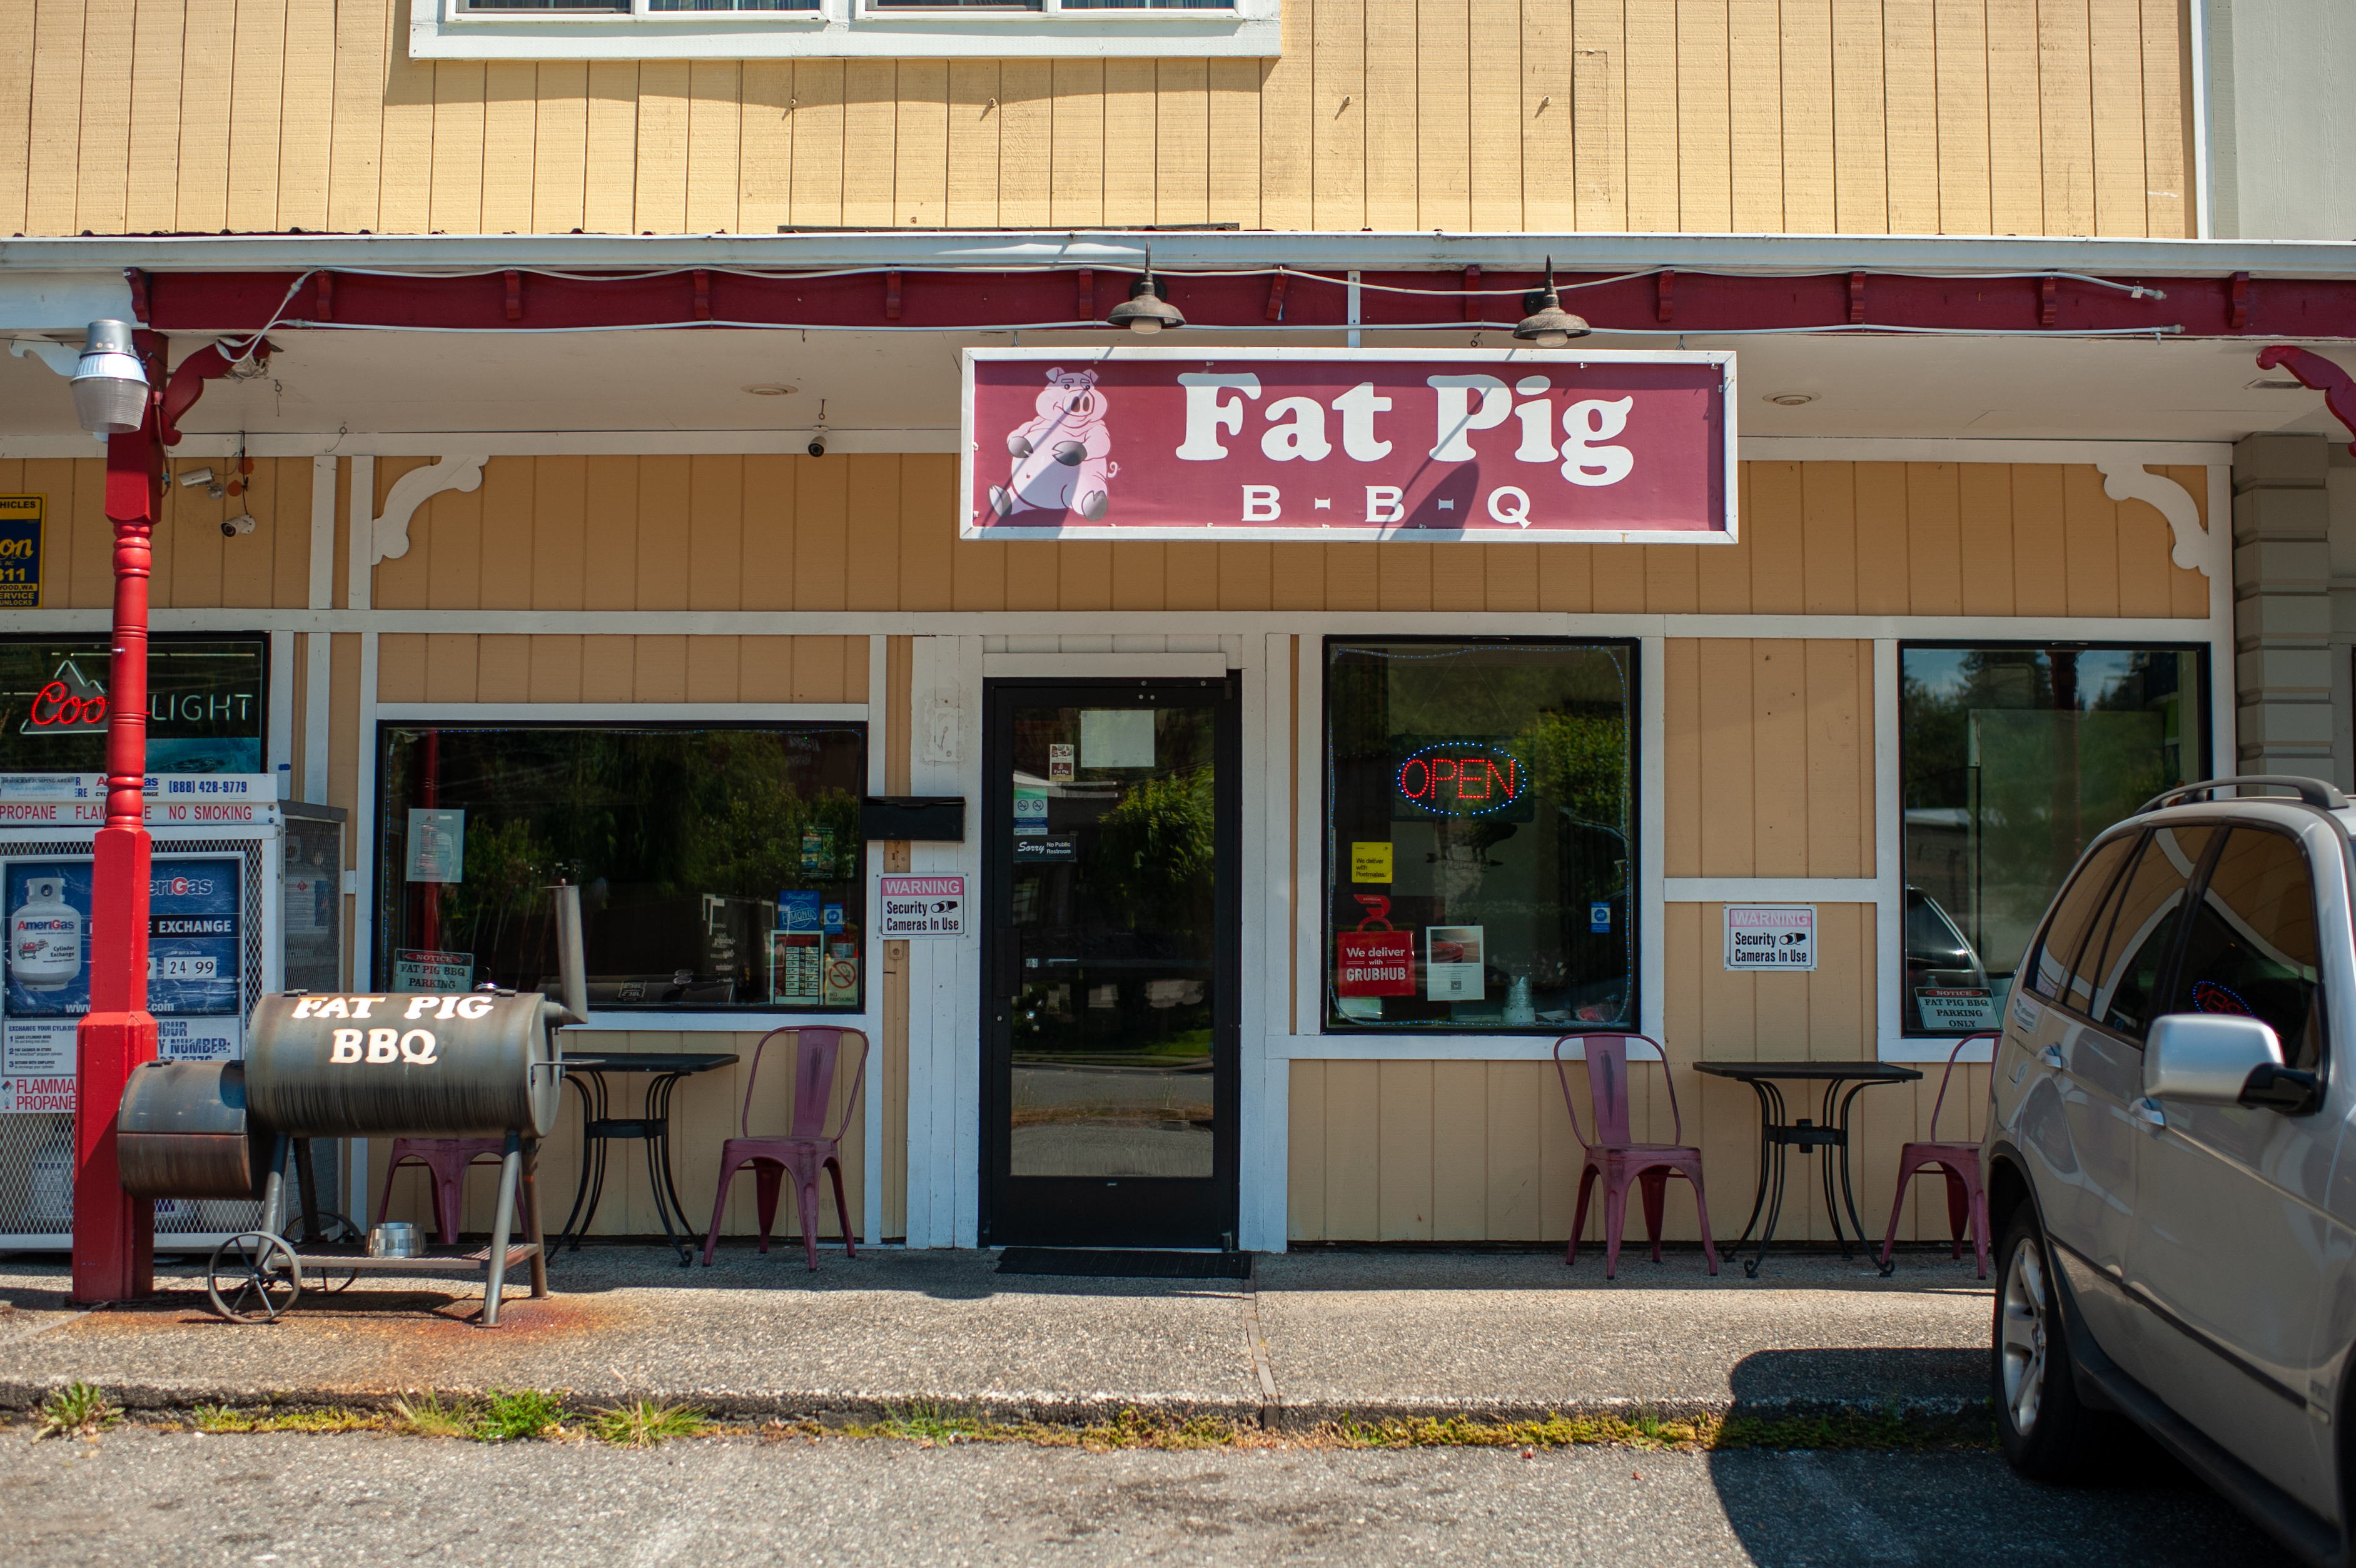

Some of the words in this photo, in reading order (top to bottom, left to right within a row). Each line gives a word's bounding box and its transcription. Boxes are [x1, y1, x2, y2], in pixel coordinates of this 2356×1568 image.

[1176, 372, 1393, 462] Fat
[1428, 374, 1635, 486] Pig
[0, 539, 34, 558] on
[31, 681, 110, 726] Coo
[151, 694, 253, 721] LIGHT
[1402, 758, 1515, 799] OPEN
[169, 781, 195, 794] (888)
[199, 781, 247, 793] 428-9779
[0, 806, 56, 820] PROPANE
[76, 806, 151, 820] FLAME
[169, 806, 186, 820] NO
[195, 806, 252, 821] SMOKING
[1018, 841, 1044, 854] Sorry
[149, 876, 213, 896] eriGas
[886, 880, 959, 894] WARNING
[887, 901, 928, 916] Security
[782, 908, 817, 925] EDMONDS
[1734, 912, 1807, 925] WARNING
[16, 919, 75, 931] AmeriGas
[159, 920, 232, 933] EXCHANGE
[887, 918, 927, 931] Cameras
[931, 918, 939, 930] In
[943, 917, 959, 930] Use
[1735, 931, 1776, 948] Security
[417, 954, 453, 963] NOTICE
[1346, 948, 1365, 958] We
[1368, 947, 1405, 957] deliver
[1735, 949, 1776, 962] Cameras
[1779, 949, 1787, 962] In
[1791, 949, 1807, 962] Use
[170, 961, 186, 974] 24
[195, 961, 214, 974] 99
[401, 964, 419, 973] FAT
[422, 965, 440, 975] PIG
[444, 967, 466, 977] BBQ
[1347, 967, 1406, 981] GRUBHUB
[408, 978, 456, 989] PARKING
[291, 996, 386, 1019] FAT
[405, 996, 493, 1019] PIG
[171, 1038, 231, 1054] NUMBER:
[330, 1028, 438, 1065] BBQ
[17, 1079, 76, 1094] FLAMMA
[17, 1096, 76, 1110] PROPANE
